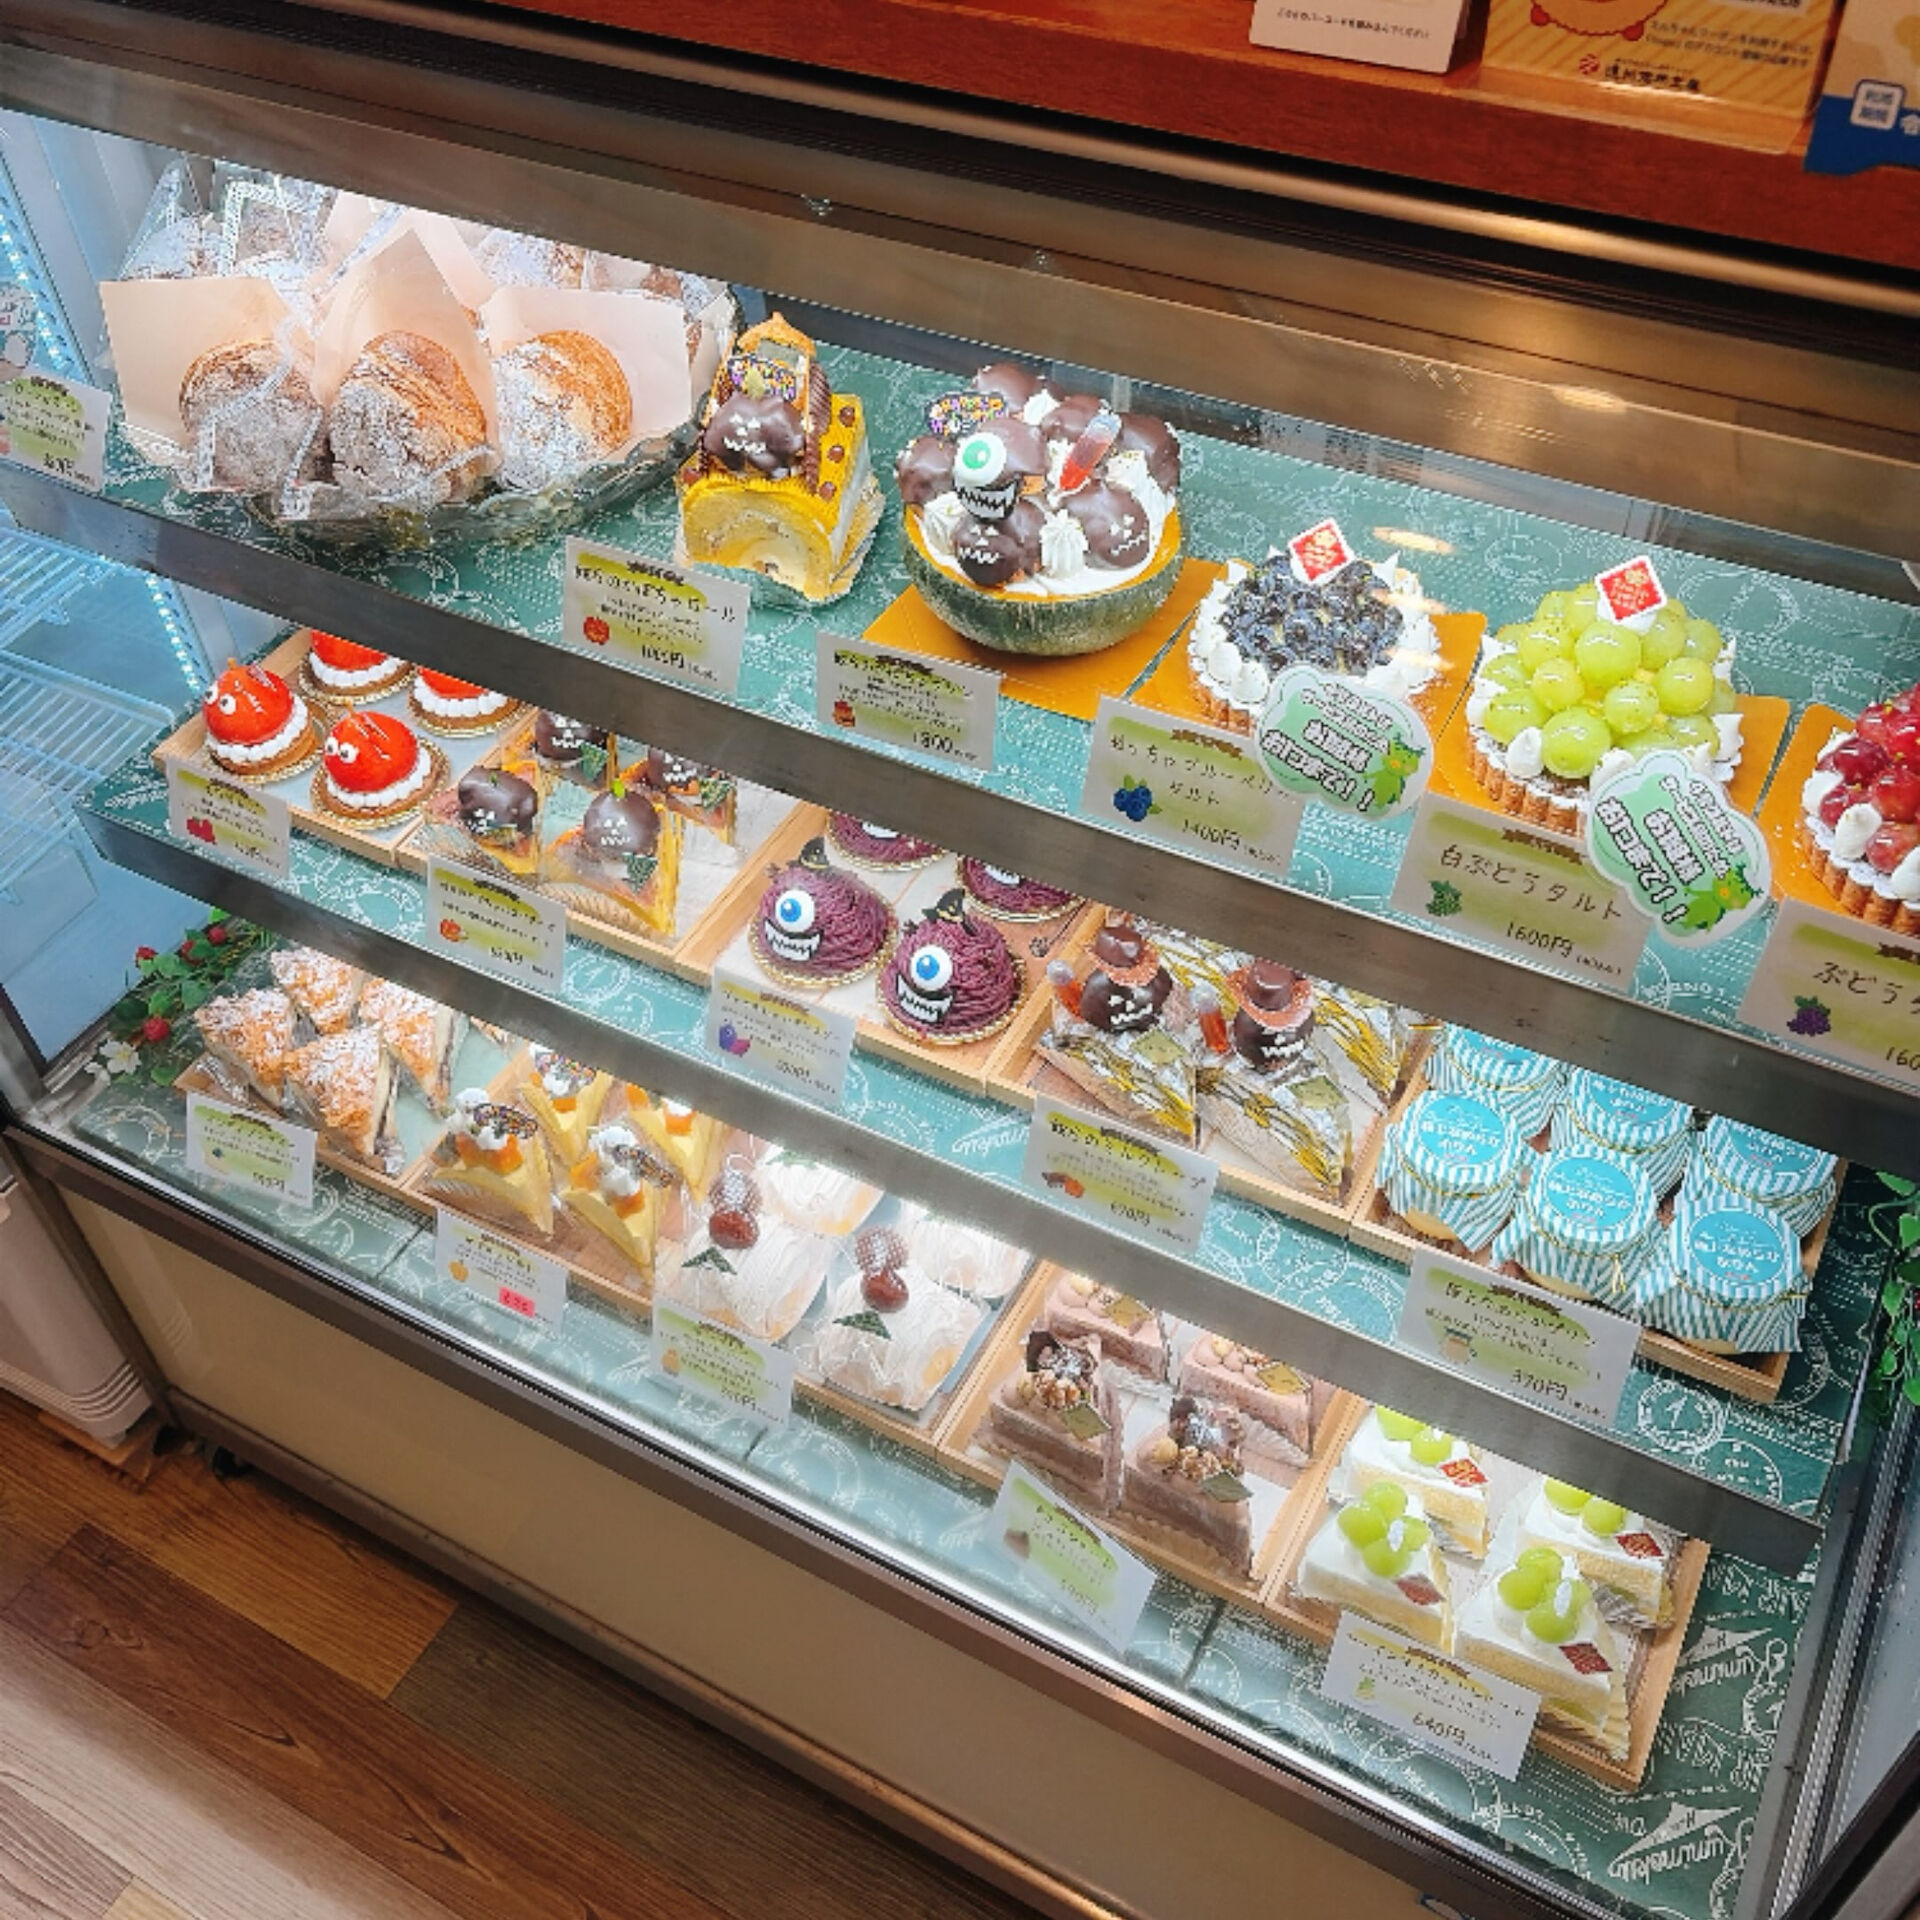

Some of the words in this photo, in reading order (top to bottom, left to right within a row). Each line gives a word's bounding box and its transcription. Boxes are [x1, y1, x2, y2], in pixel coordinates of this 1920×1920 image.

[1440, 843, 1623, 921] 白ぶどうタルト
[1506, 921, 1574, 958] 1600円
